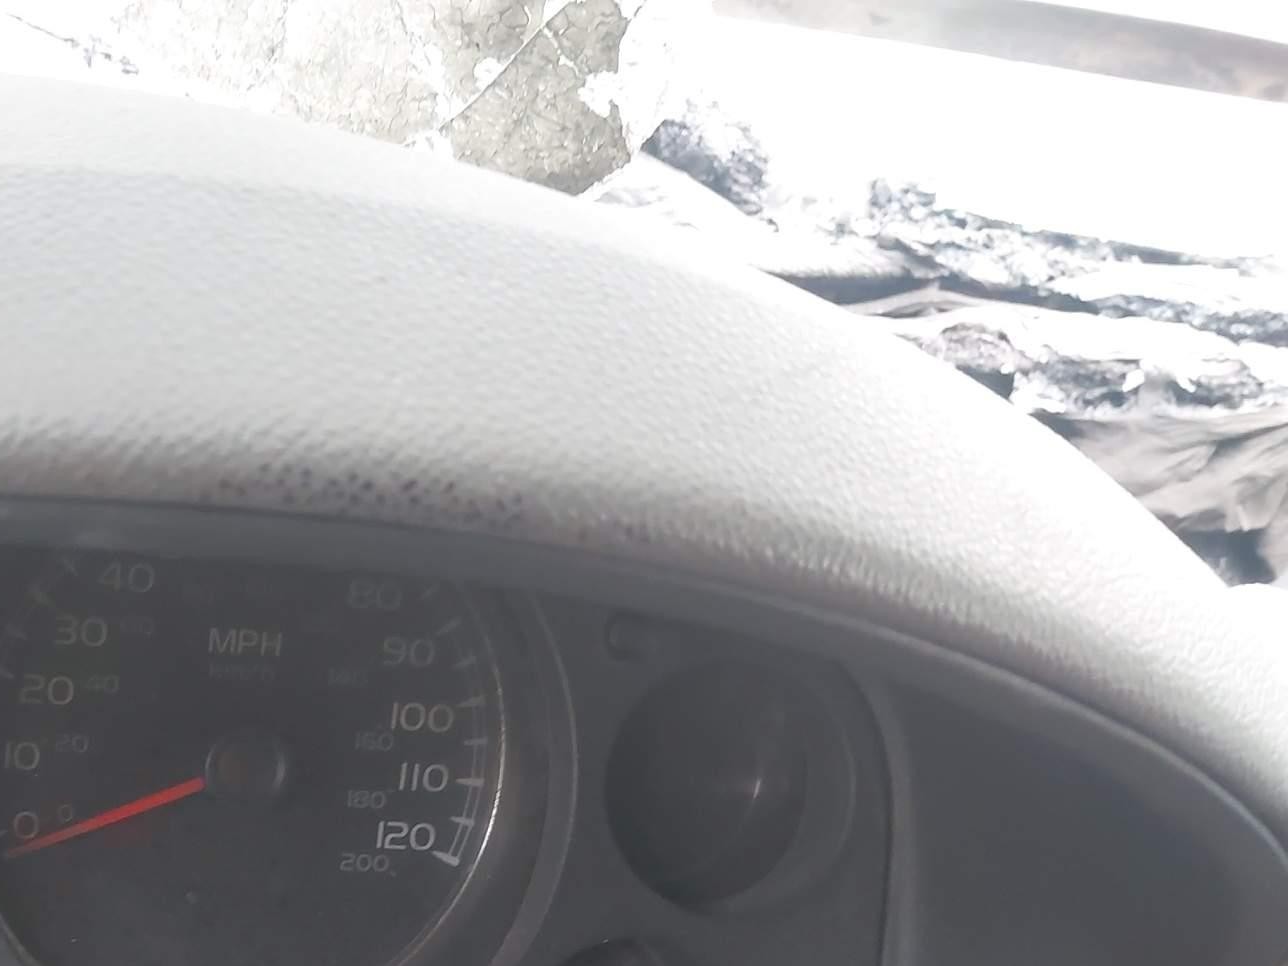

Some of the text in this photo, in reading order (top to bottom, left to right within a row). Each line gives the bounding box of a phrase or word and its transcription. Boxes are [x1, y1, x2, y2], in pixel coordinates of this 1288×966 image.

[97, 560, 156, 594] 40
[346, 576, 404, 612] 80
[53, 613, 109, 648] 30
[207, 626, 283, 658] MPH
[380, 633, 437, 668] 90
[18, 673, 76, 706] 20
[390, 700, 455, 734] 100
[3, 740, 42, 771] 10
[54, 732, 90, 755] 20
[354, 730, 396, 752] 160
[397, 760, 450, 793] 110
[12, 810, 40, 840] 0
[56, 803, 76, 824] 0
[375, 820, 437, 852] 120
[339, 850, 392, 873] 200
